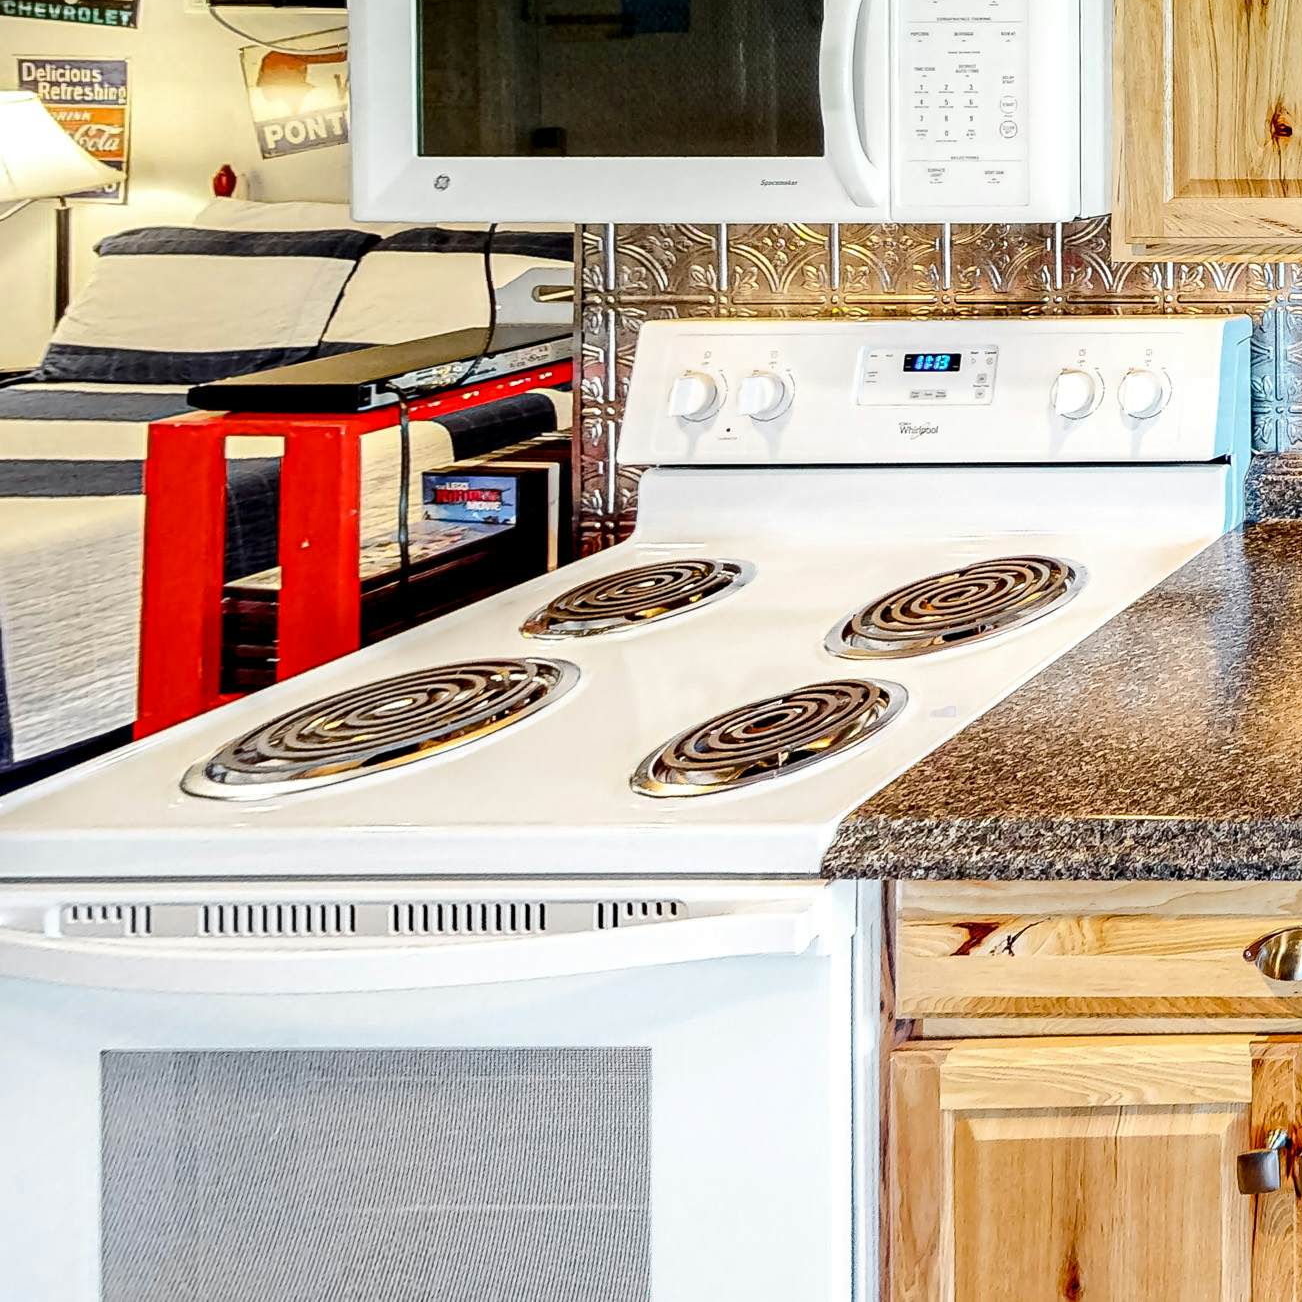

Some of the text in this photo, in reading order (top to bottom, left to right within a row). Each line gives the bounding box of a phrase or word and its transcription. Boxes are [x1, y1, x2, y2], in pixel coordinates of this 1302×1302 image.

[2, 0, 133, 27] CHEVROLET
[21, 61, 104, 83] Delicious
[38, 81, 127, 105] Refreshing
[52, 110, 92, 122] RINK
[263, 111, 349, 149] PONT
[914, 354, 951, 370] 11:13
[899, 425, 939, 437] Whirlpool
